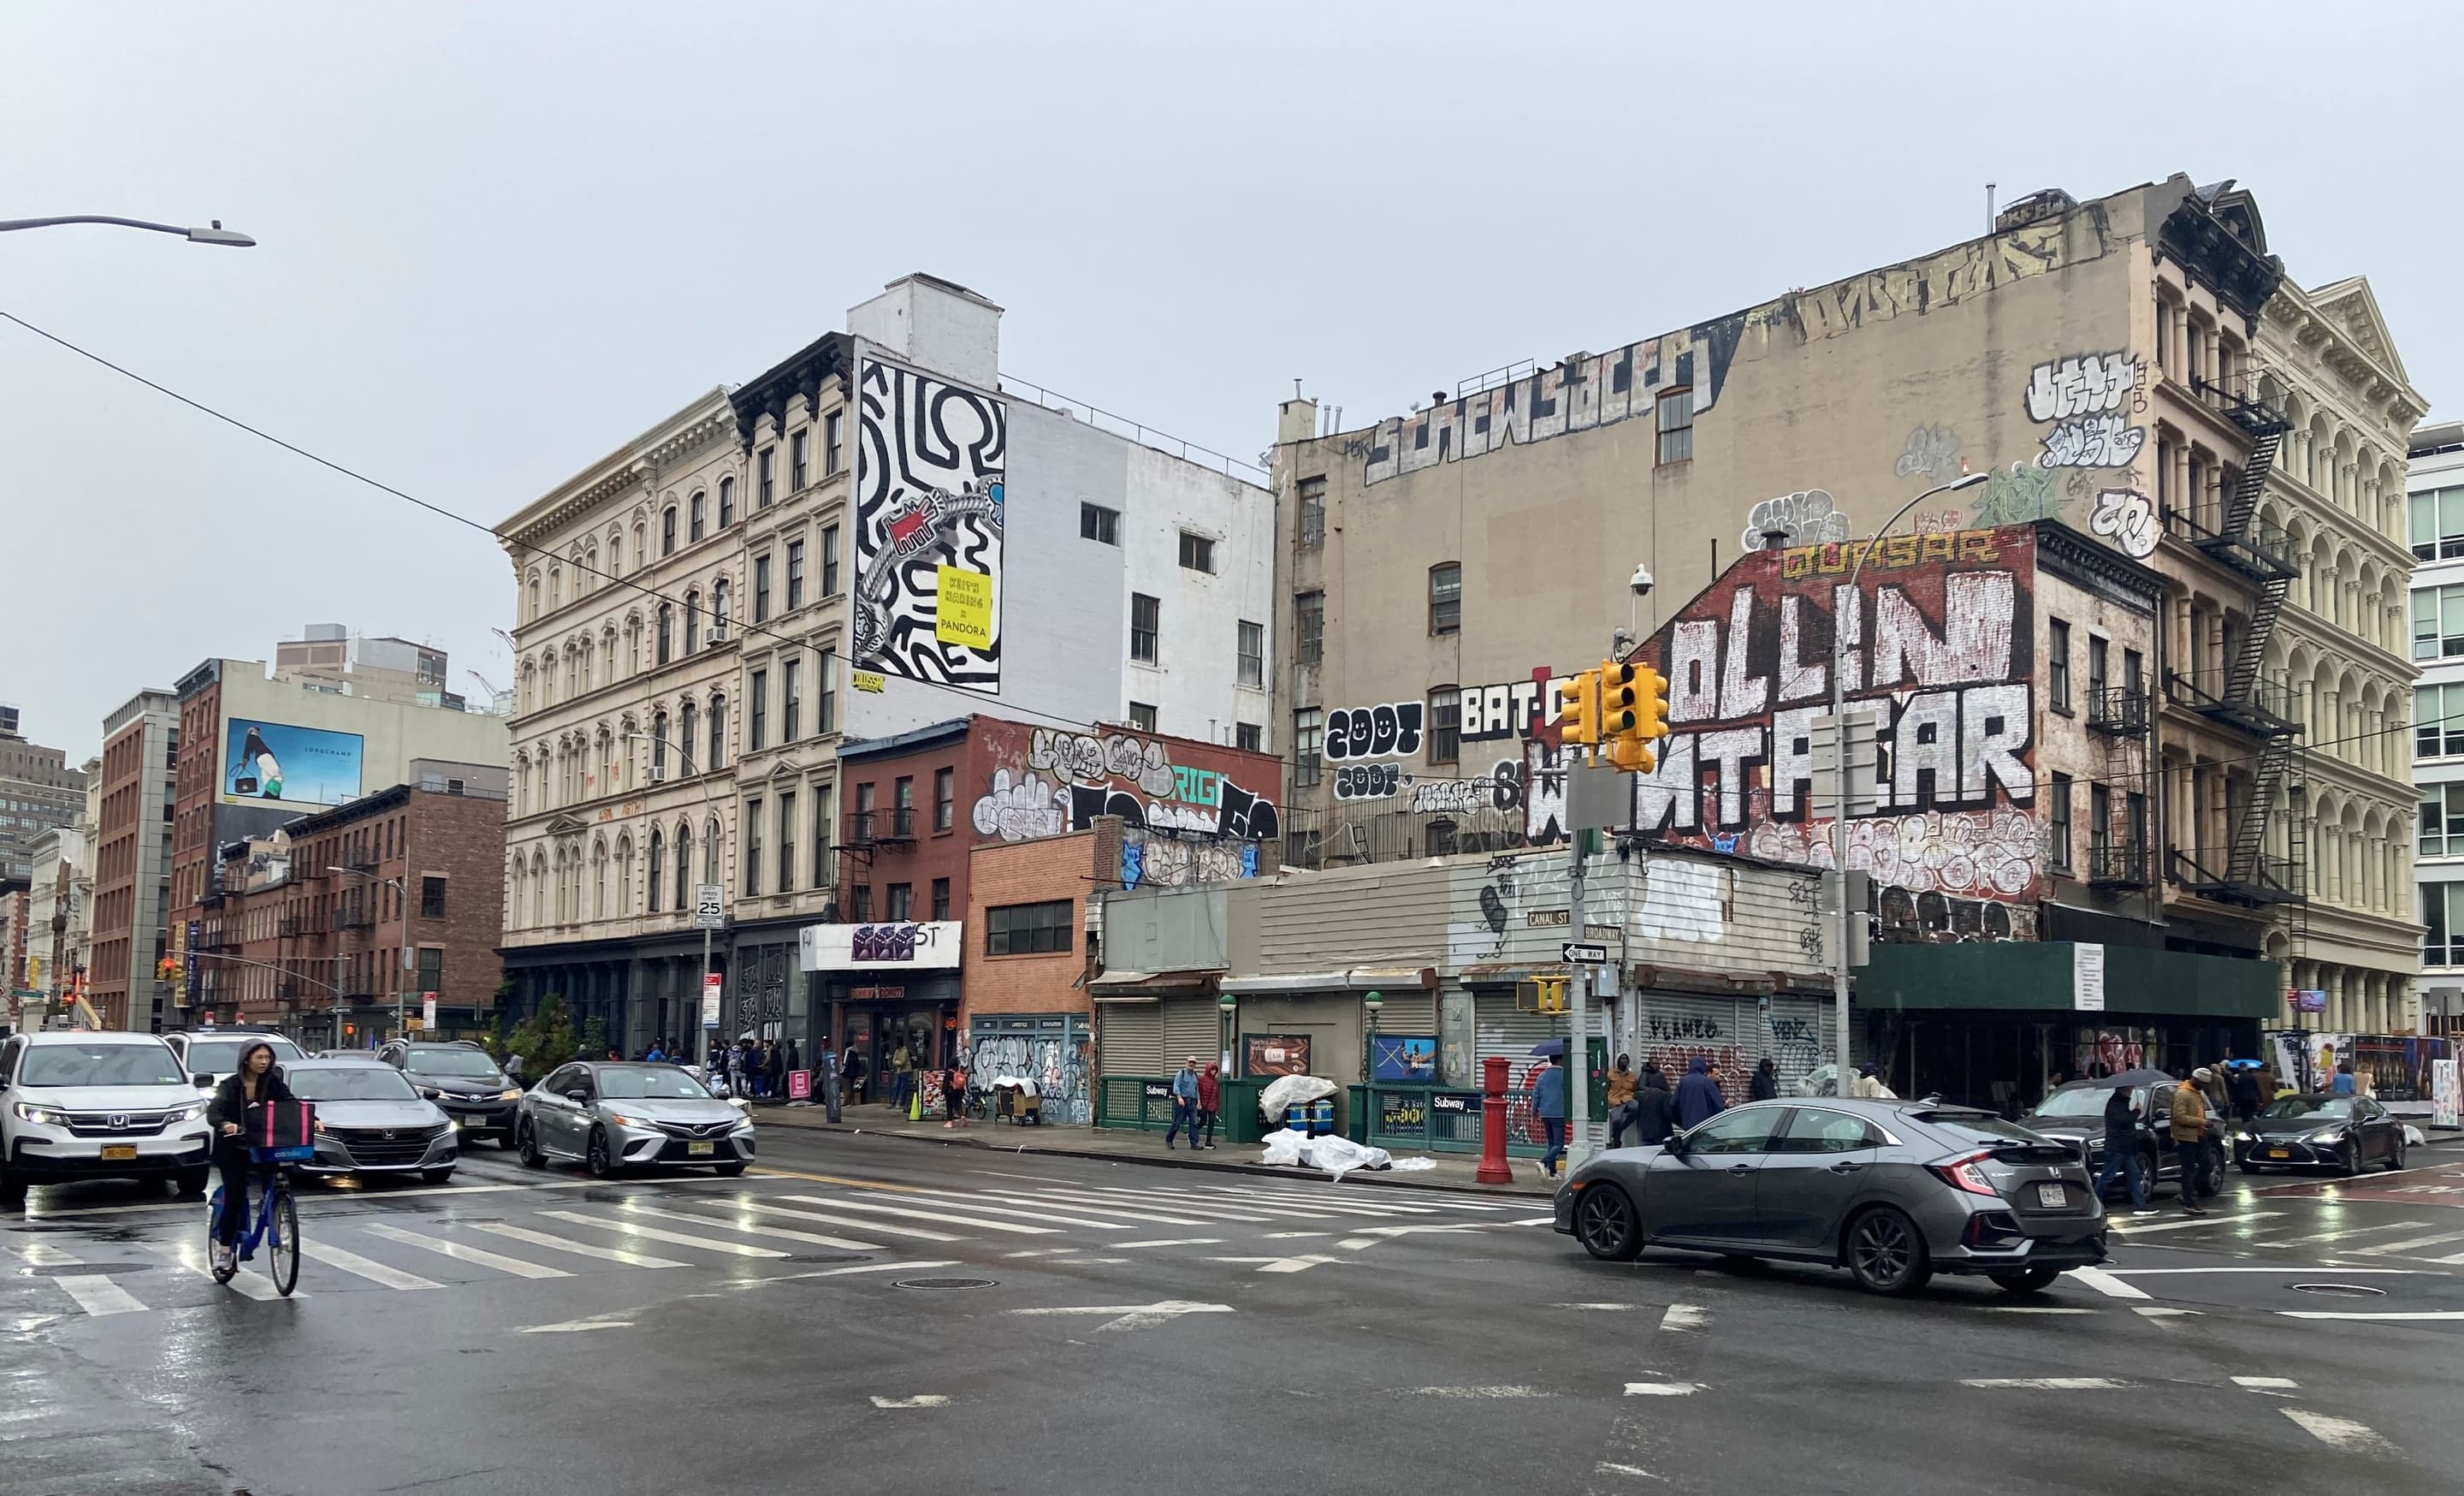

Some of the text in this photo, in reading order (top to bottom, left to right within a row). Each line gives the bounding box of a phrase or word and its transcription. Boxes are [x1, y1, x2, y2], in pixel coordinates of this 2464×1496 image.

[1782, 530, 1999, 579] QUASAR
[945, 590, 983, 608] HARING
[941, 619, 986, 638] PANDORA
[305, 746, 352, 757] LONGCHAMP
[699, 902, 720, 915] 25
[1529, 911, 1568, 926] CANAL ST
[1584, 927, 1621, 941] BROADWAY
[1568, 949, 1582, 958] ONE
[1146, 1085, 1168, 1097] Subway
[1434, 1096, 1465, 1111] Subway
